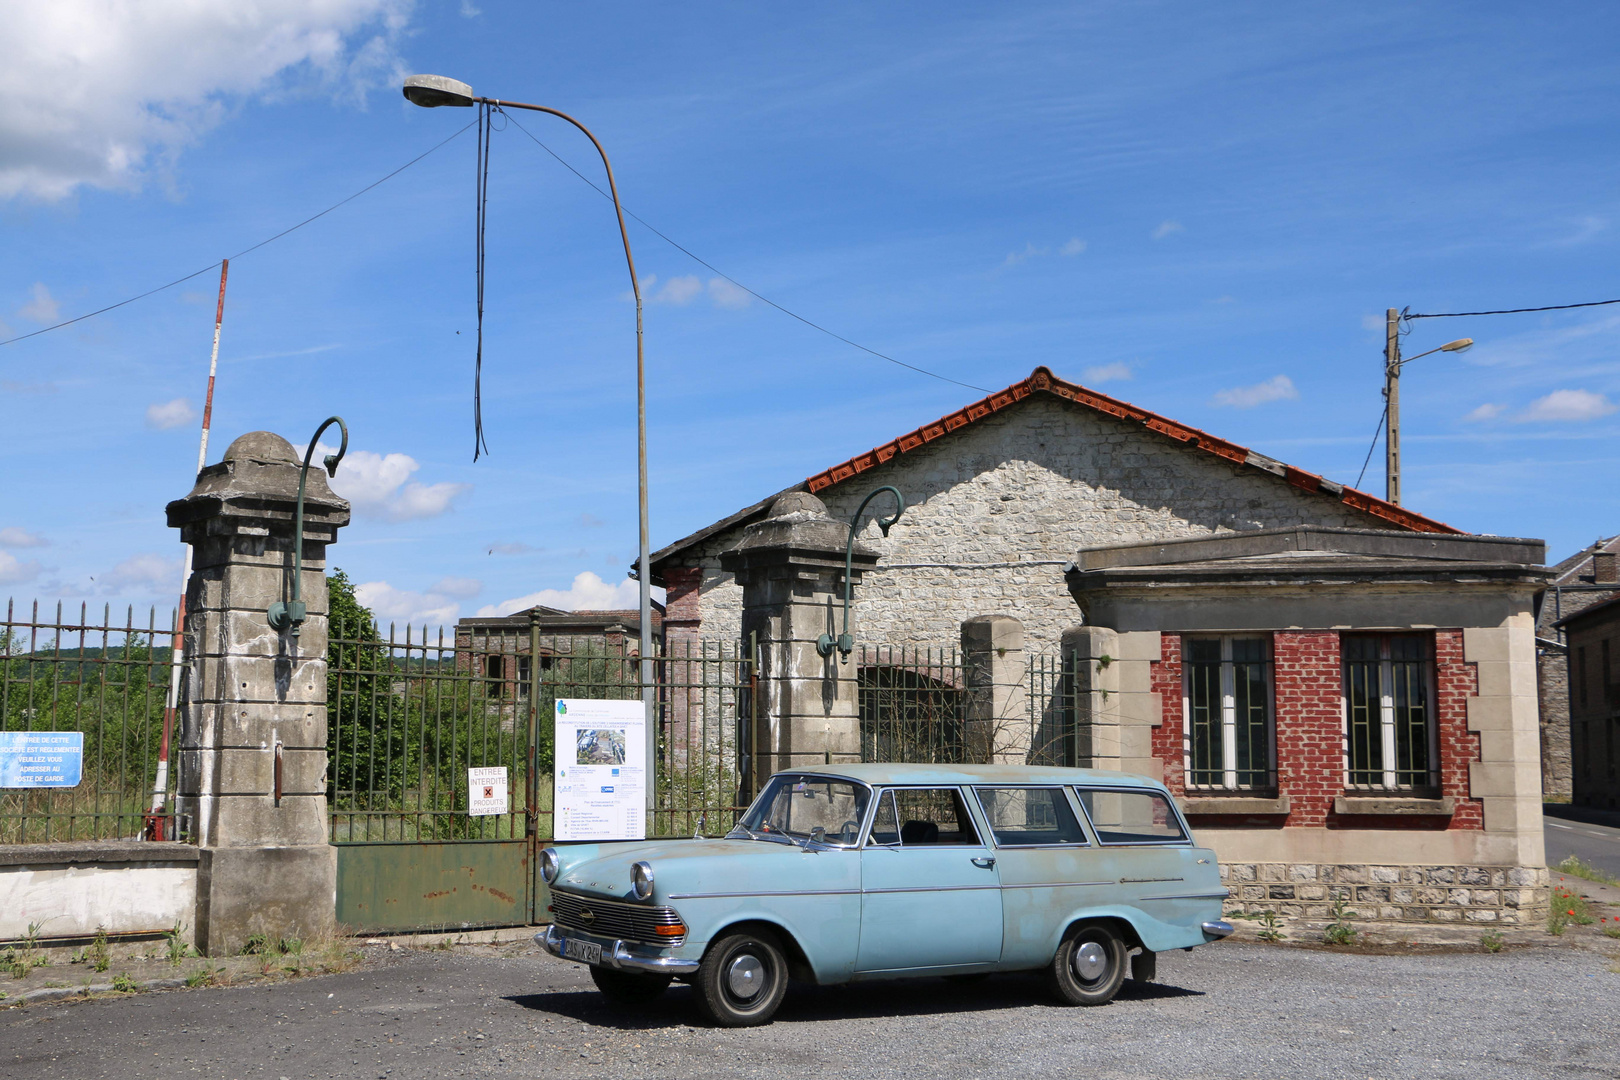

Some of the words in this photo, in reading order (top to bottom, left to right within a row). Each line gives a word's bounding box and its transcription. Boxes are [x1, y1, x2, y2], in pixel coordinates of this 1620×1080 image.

[470, 777, 507, 786] INTERDITE
[470, 807, 507, 815] DANGEREUX
[566, 940, 577, 956] CAS
[582, 944, 587, 959] X
